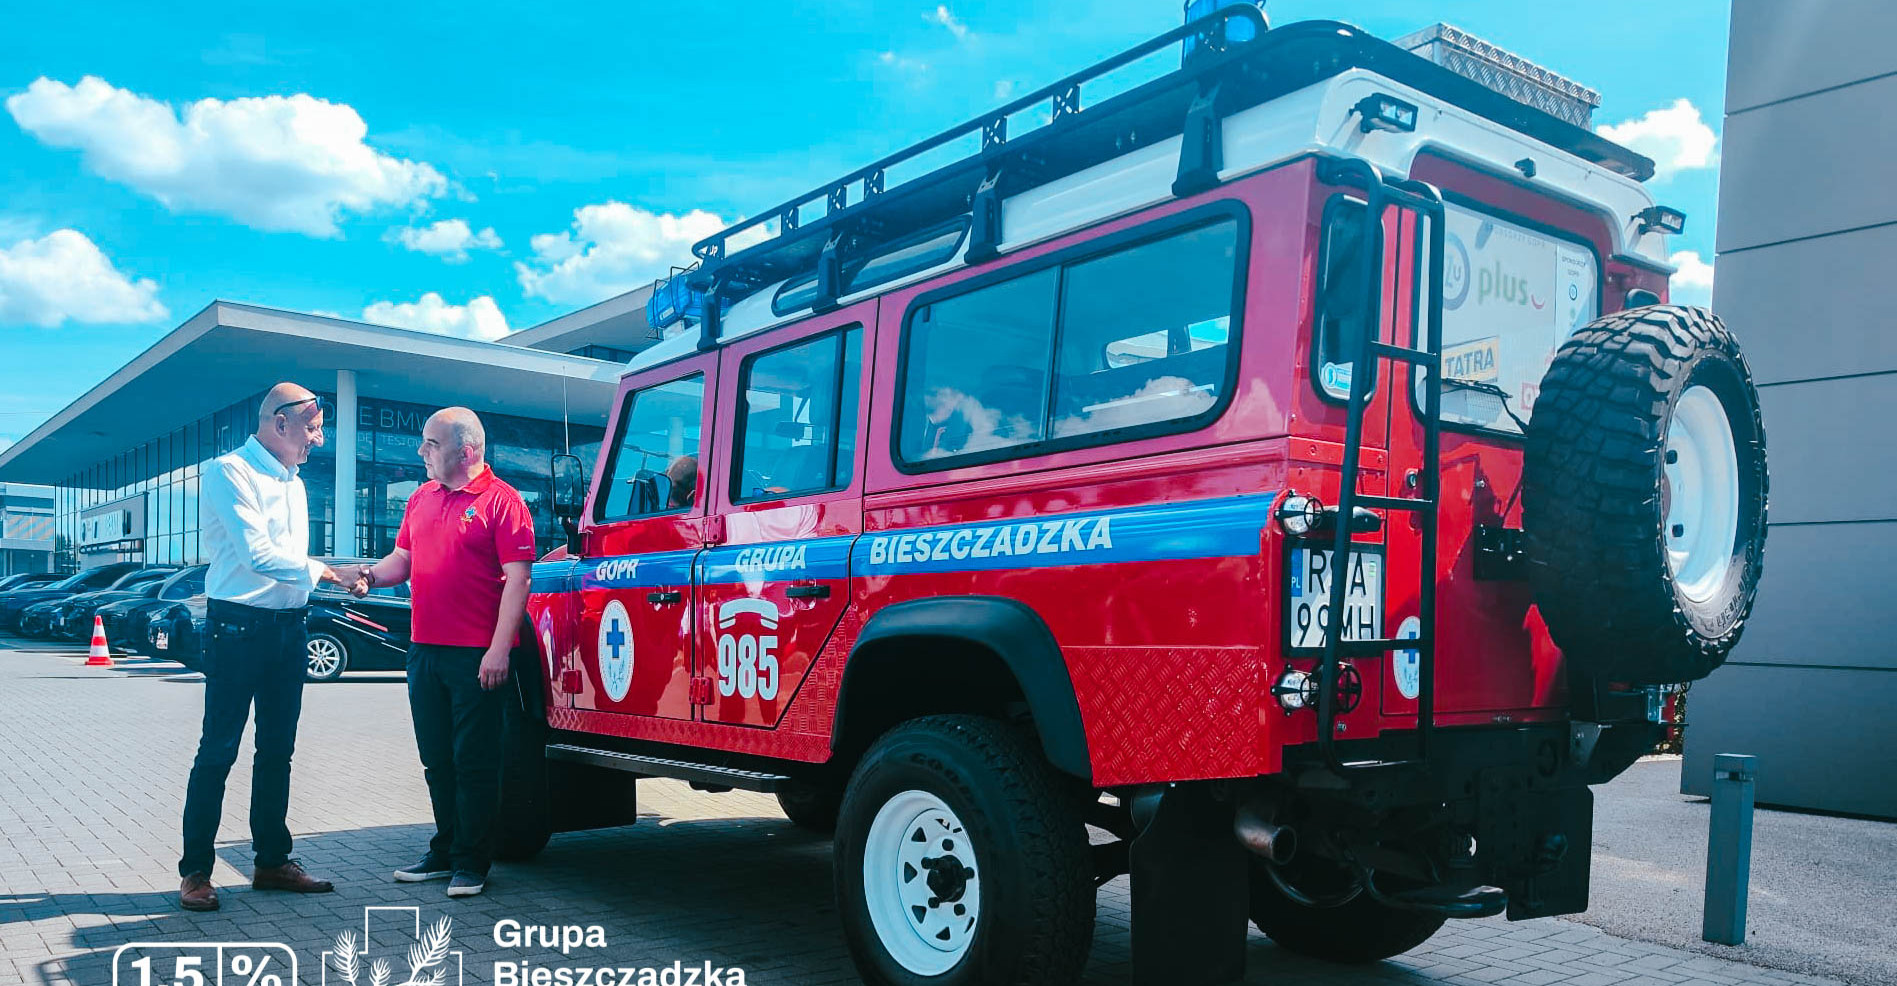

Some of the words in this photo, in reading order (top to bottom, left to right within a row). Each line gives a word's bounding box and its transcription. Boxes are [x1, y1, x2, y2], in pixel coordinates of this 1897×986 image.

[1478, 260, 1529, 306] plus
[1445, 347, 1495, 378] TATRA
[735, 545, 807, 573] GRUPA
[869, 516, 1113, 565] BIESZCZADZKA
[595, 559, 640, 582] GOPR
[1291, 576, 1301, 589] PL
[1309, 549, 1367, 595] RA
[718, 633, 779, 701] 985
